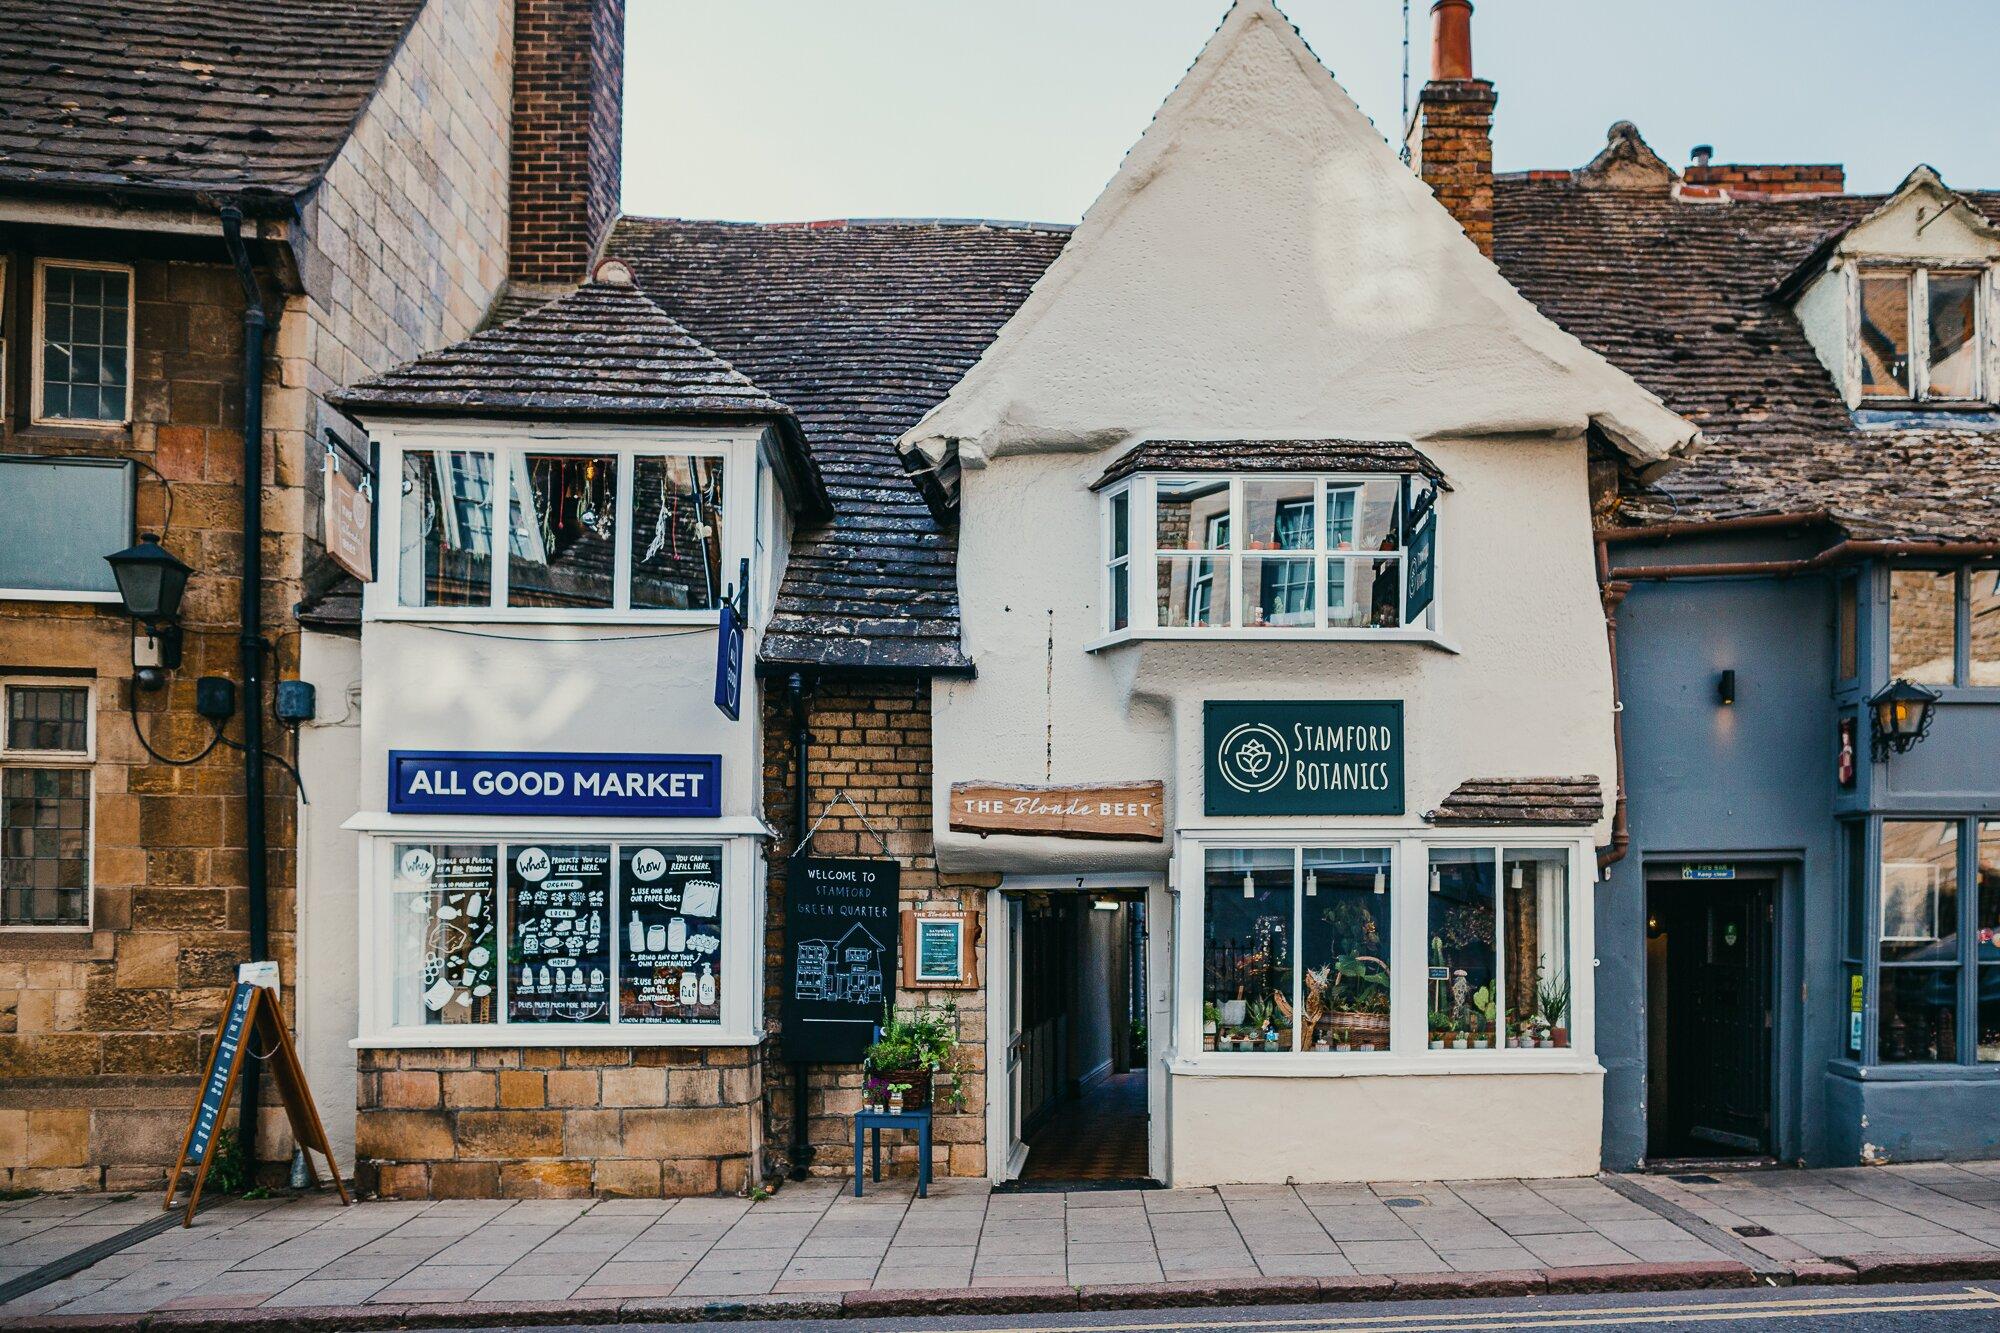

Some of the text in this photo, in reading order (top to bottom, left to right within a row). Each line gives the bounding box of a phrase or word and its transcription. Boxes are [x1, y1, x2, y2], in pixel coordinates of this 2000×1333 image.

[1294, 722, 1390, 752] STAMFORD
[1296, 760, 1388, 790] BOTANICS
[408, 770, 704, 797] ALL GOOD MARKET
[964, 797, 1151, 816] THE Blonde BEET
[637, 857, 661, 874] how
[671, 862, 711, 870] REFILL HERE.
[808, 869, 876, 882] WELCOME TO
[1076, 878, 1084, 887] 7
[816, 886, 872, 898] STAMFORD
[798, 904, 888, 918] GREEN QUARTER
